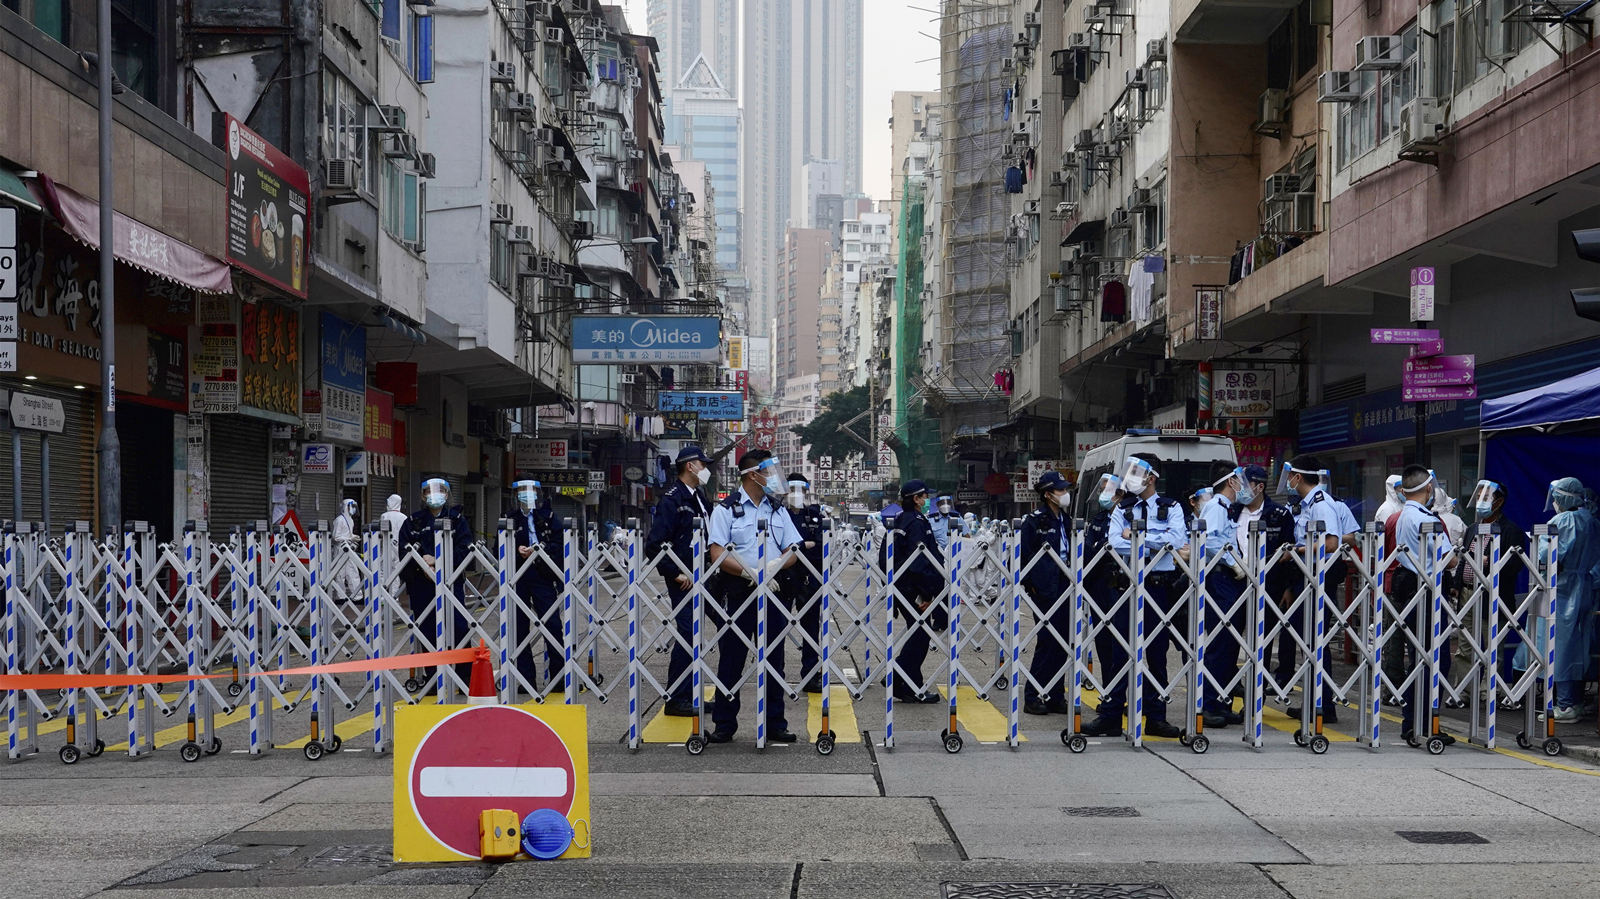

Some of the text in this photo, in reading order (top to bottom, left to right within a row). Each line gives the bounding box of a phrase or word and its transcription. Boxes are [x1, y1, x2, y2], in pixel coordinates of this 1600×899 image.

[233, 171, 245, 198] 1/F
[1419, 288, 1426, 301] Ma
[204, 337, 235, 346] 2770 8819
[592, 328, 701, 345] 美的 Midea
[591, 351, 662, 360] 廣雅電業公司
[205, 382, 236, 391] 2770 8819
[1226, 372, 1257, 388] 恩恩
[1214, 389, 1272, 401] 理髮美容屋
[204, 403, 236, 412] 2770 8819
[1364, 407, 1394, 428] 香港賽馬會
[1395, 405, 1404, 422] The
[757, 432, 773, 448] 押
[879, 416, 890, 465] 同五金
[821, 457, 831, 466] 大
